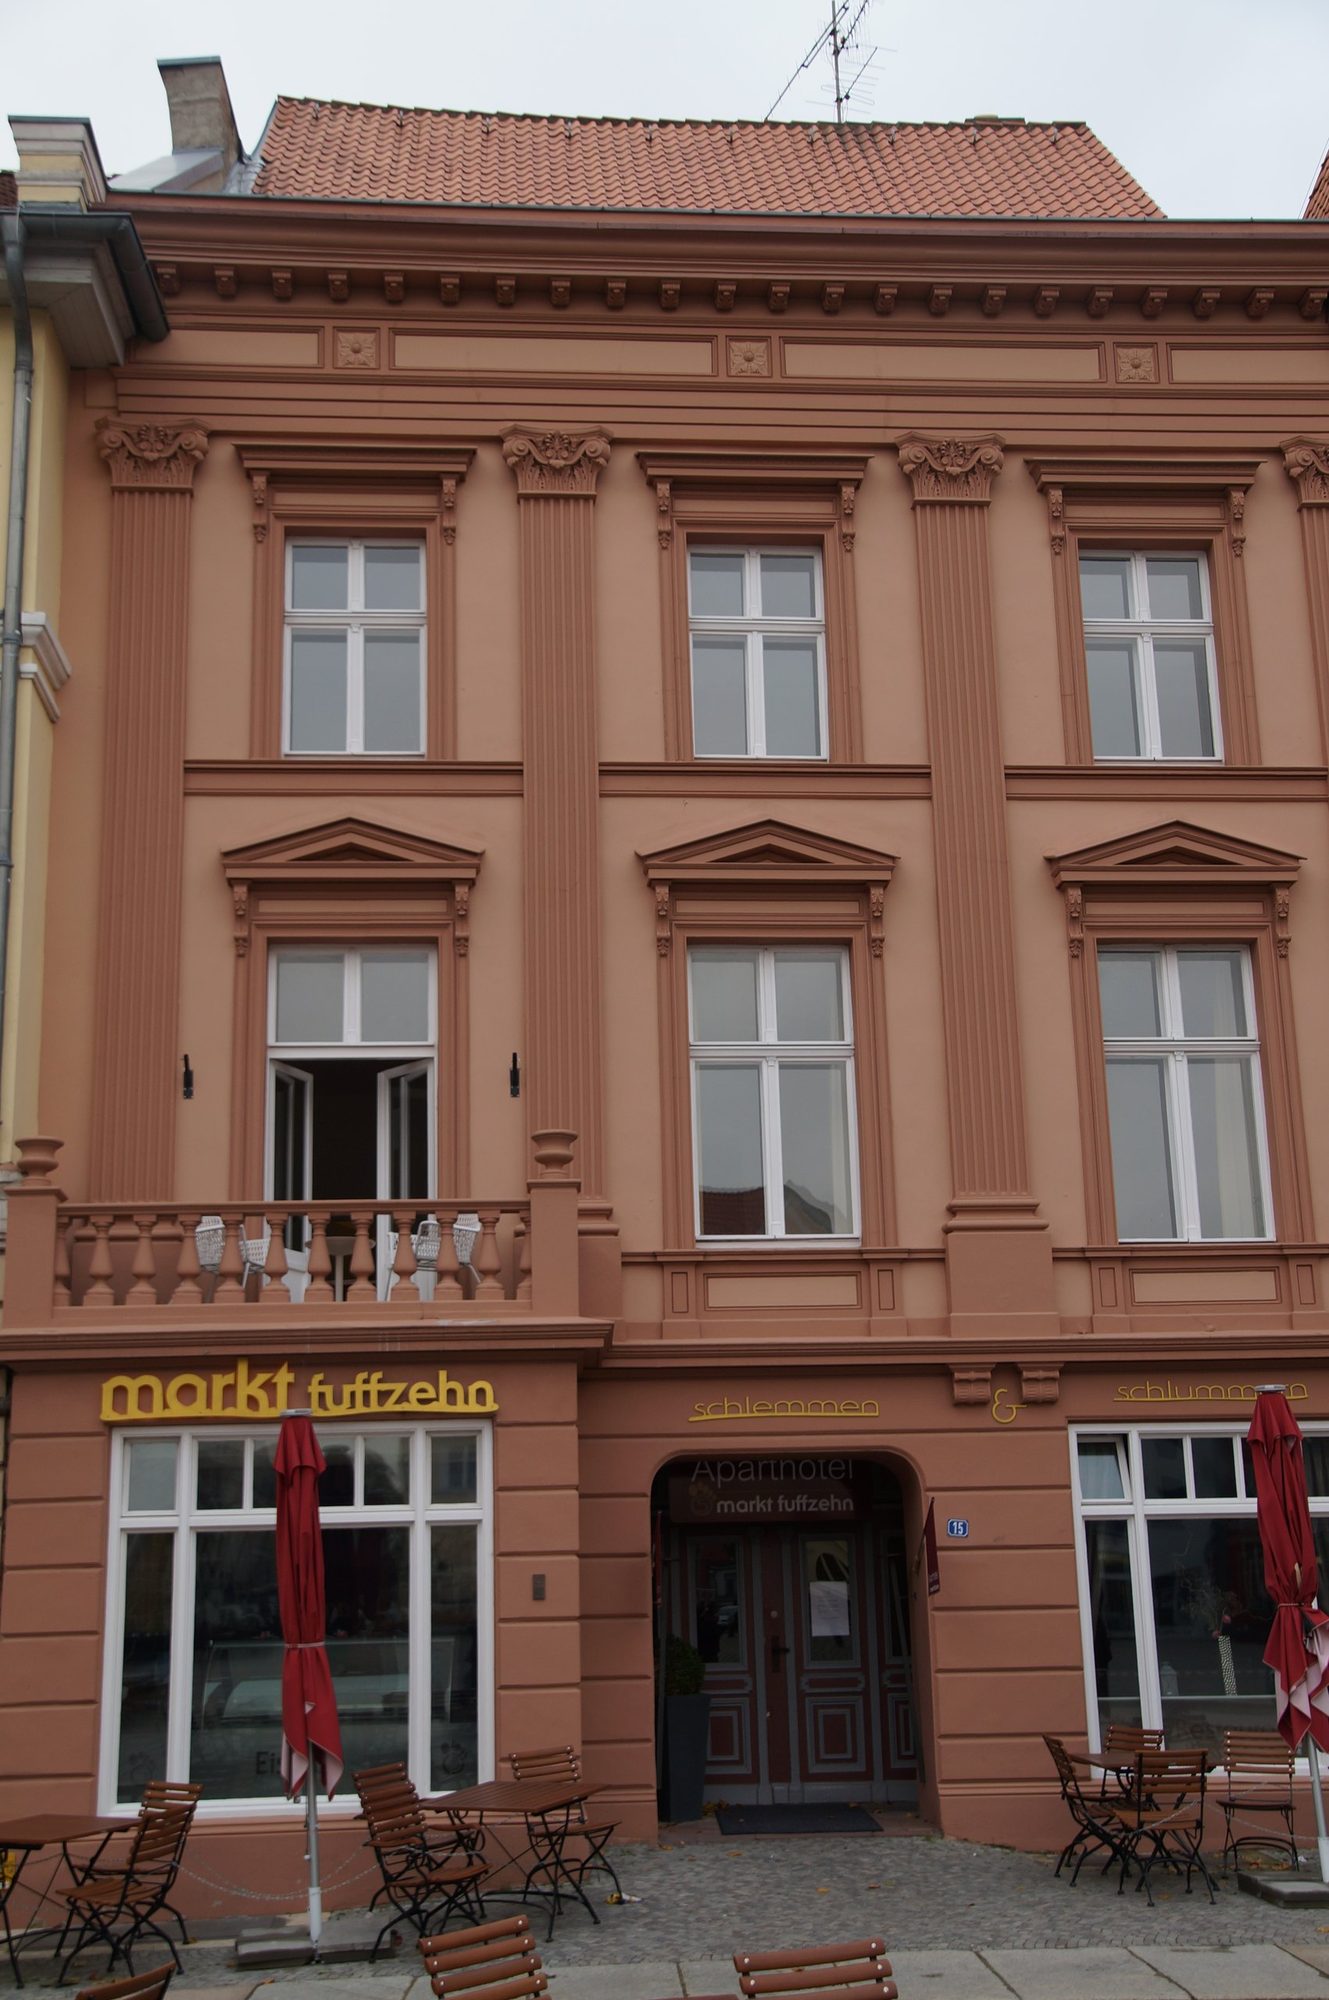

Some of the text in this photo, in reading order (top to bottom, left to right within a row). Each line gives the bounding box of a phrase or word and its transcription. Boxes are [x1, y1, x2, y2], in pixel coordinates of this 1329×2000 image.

[101, 1358, 498, 1419] markt fuffzehn
[688, 1380, 1309, 1423] schlemmen & schlummn
[716, 1494, 854, 1513] markt fuffzehn
[952, 1521, 964, 1535] 15
